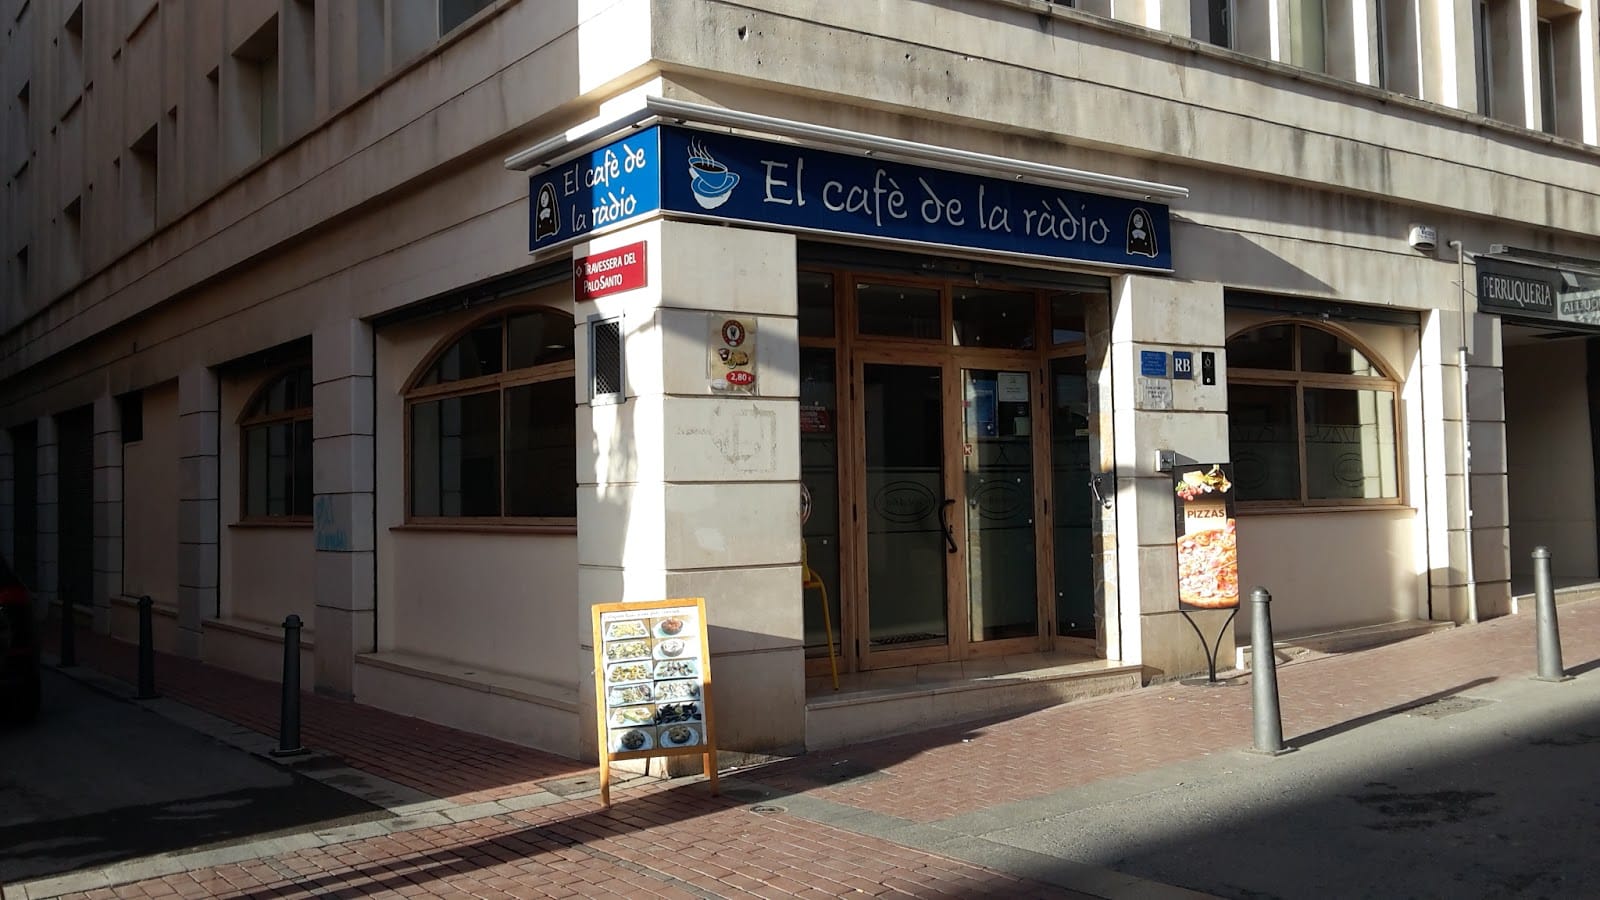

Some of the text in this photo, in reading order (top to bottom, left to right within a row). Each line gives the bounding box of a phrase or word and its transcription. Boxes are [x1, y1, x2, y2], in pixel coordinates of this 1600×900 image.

[563, 143, 646, 197] El cafè de
[572, 186, 637, 233] la ràdio
[760, 158, 1111, 245] El cafè de la ràdio
[584, 252, 637, 276] TRAVESSERA DEL
[1483, 276, 1552, 307] PERRUQUERIA
[730, 372, 747, 383] 2,80
[1175, 357, 1191, 372] RB
[1187, 508, 1225, 519] PIZZAS
